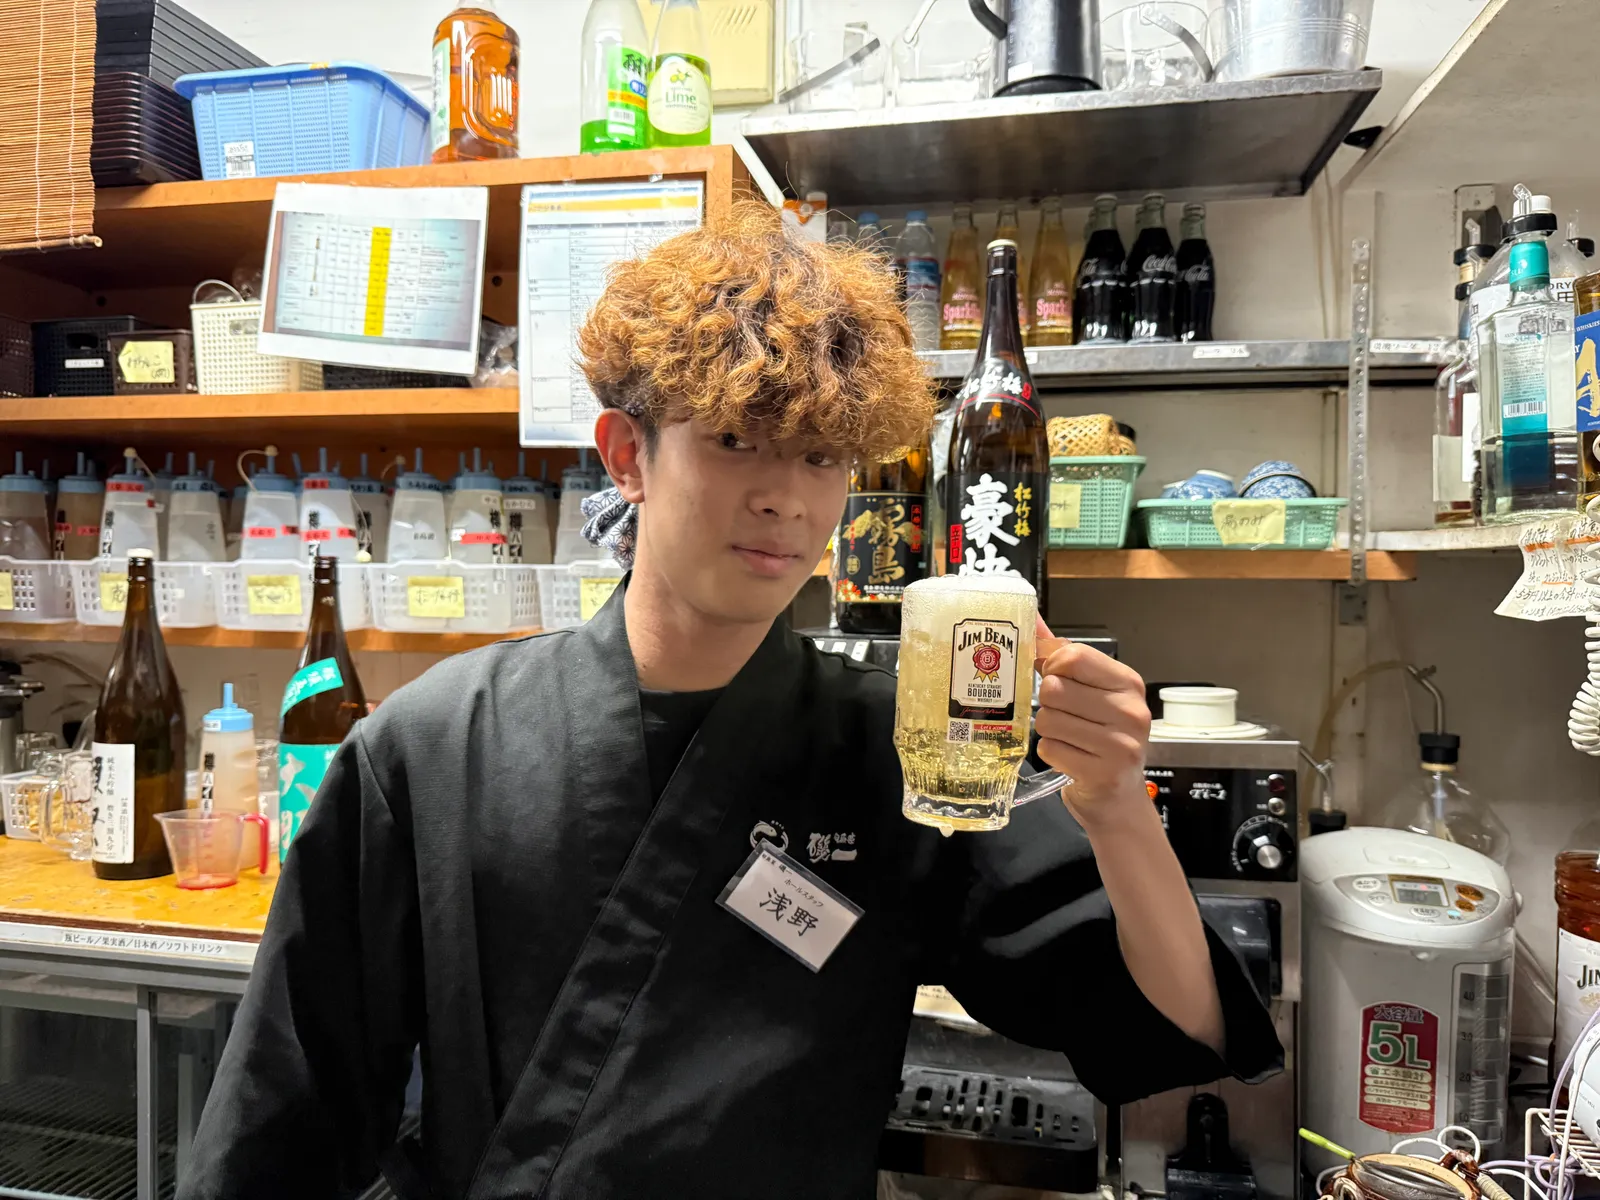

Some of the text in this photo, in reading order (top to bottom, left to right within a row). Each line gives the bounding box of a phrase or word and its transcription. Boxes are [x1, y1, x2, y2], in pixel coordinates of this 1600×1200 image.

[665, 91, 697, 105] Lime
[1013, 481, 1032, 537] 松竹梅
[958, 627, 1013, 654] JIM BEAM
[967, 688, 1002, 698] BOURBON
[1189, 789, 1227, 800] Ti-1
[784, 878, 824, 908] ホールスタッフ
[759, 887, 819, 937] 浅野
[1374, 1004, 1424, 1024] 大容量
[1366, 1020, 1431, 1069] 5L
